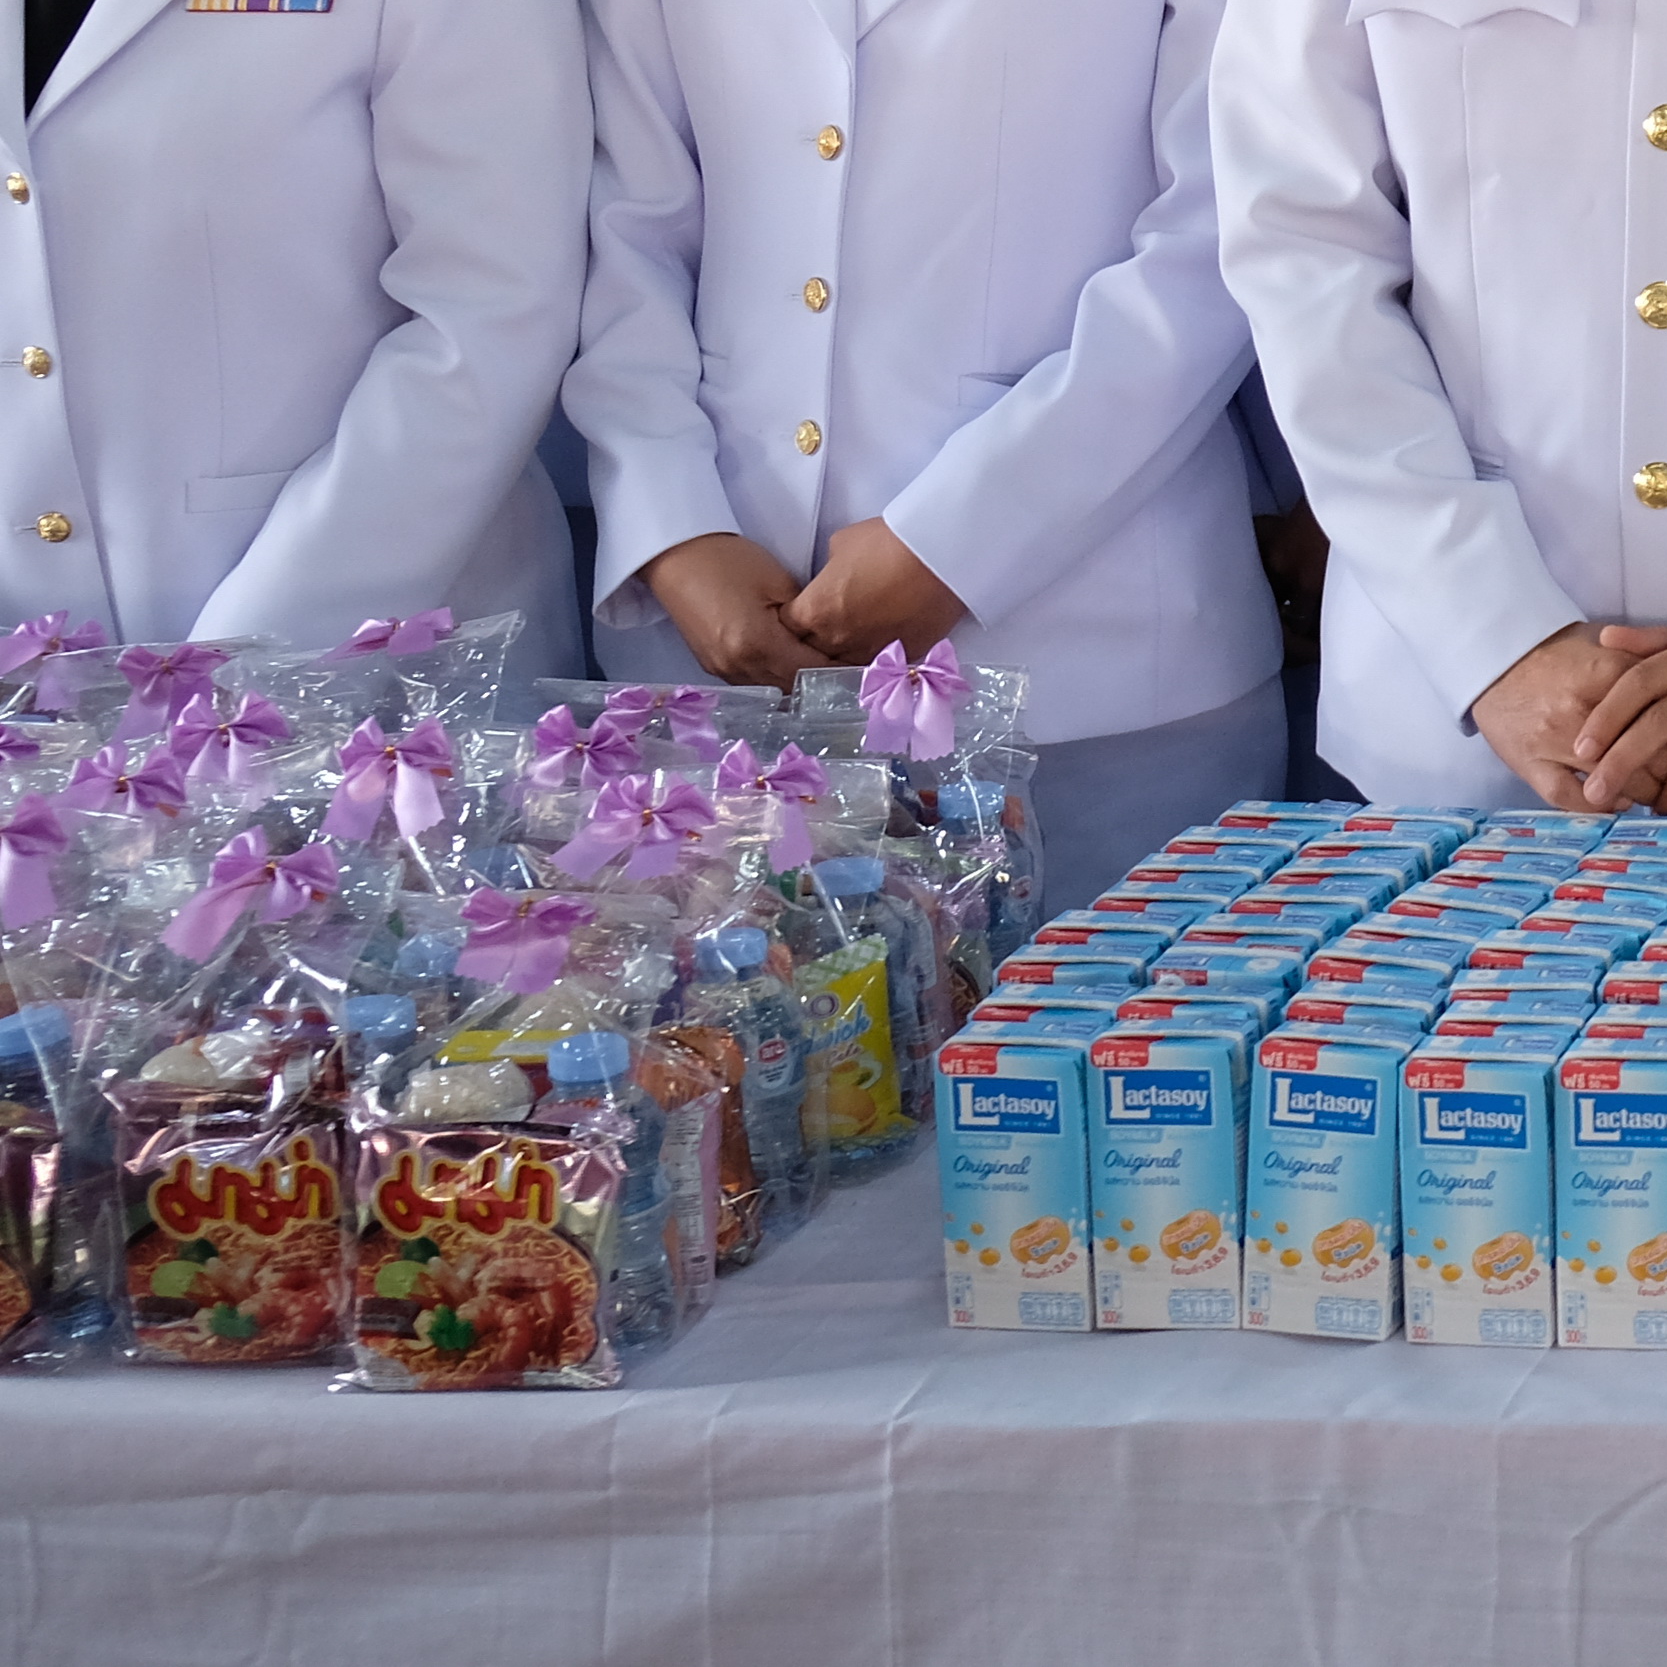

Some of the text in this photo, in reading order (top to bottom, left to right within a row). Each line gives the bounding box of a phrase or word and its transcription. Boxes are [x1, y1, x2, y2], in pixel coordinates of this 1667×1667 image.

[957, 1083, 1056, 1126] Lactasoy
[1108, 1076, 1209, 1119] Lactasoy
[1273, 1078, 1374, 1123] Lactasoy
[1424, 1097, 1524, 1140] Lactasoy
[953, 1155, 1031, 1183] Original
[1103, 1149, 1183, 1176] Original
[1263, 1150, 1344, 1179] Original
[1416, 1169, 1497, 1196] Original
[1571, 1171, 1652, 1197] Original
